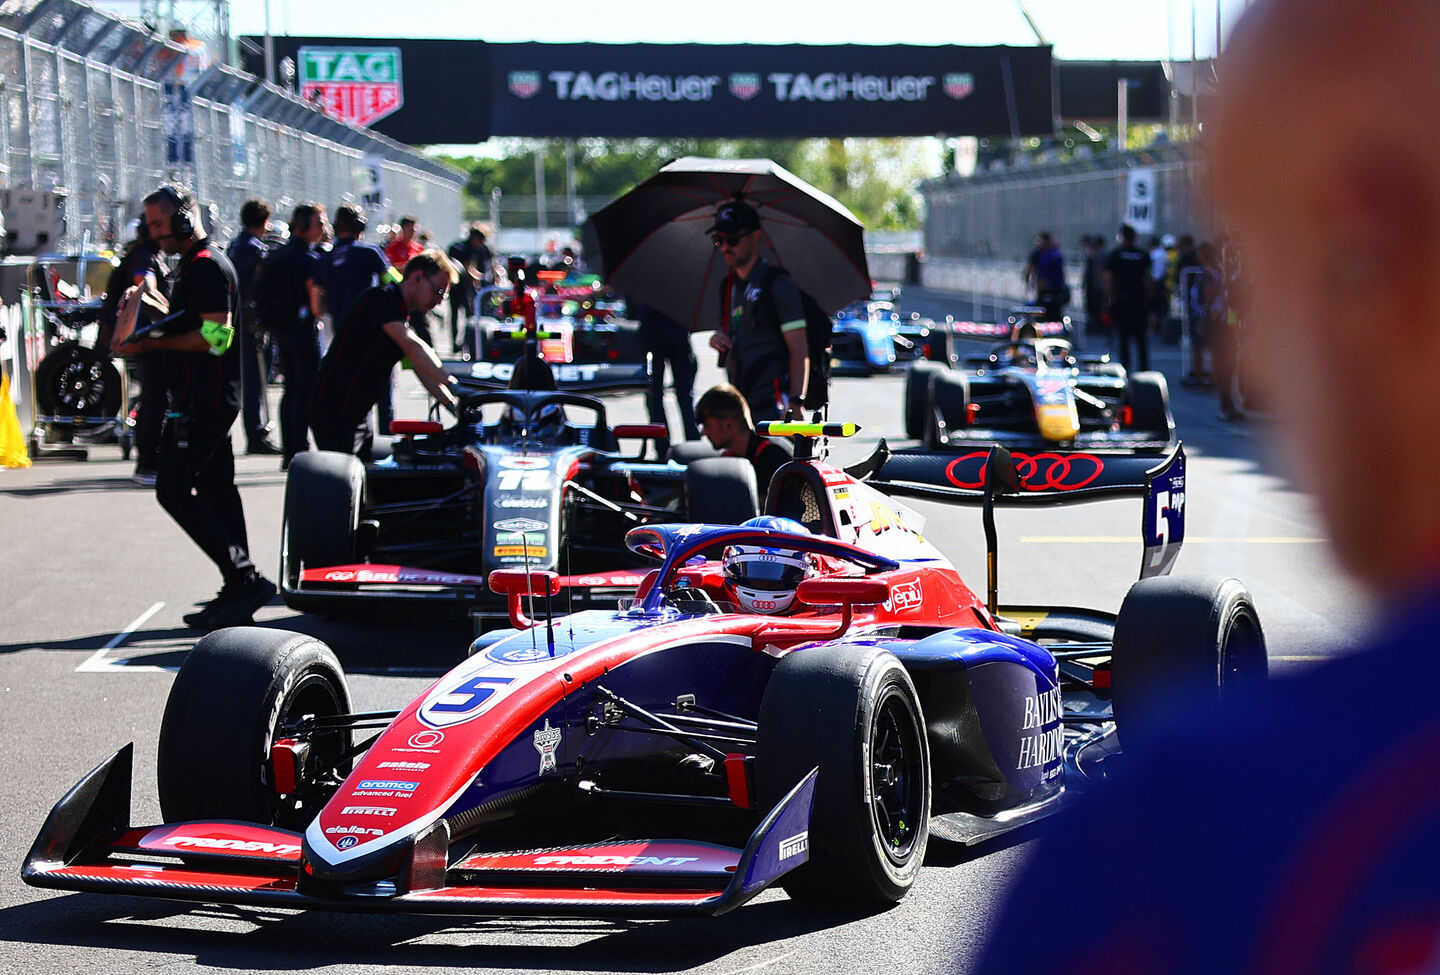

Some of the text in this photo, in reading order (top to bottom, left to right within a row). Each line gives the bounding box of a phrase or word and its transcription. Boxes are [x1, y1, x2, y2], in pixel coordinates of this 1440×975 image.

[308, 54, 393, 80] TAG
[1149, 490, 1170, 568] 5
[428, 676, 517, 713] 5
[360, 781, 415, 790] aramco
[351, 790, 414, 799] advanced fuel
[340, 806, 398, 817] PIRELLI
[325, 825, 384, 836] dallara
[162, 835, 302, 855] TRIDENT
[778, 831, 809, 862] PIRELLI
[533, 855, 699, 867] TRIDENT
